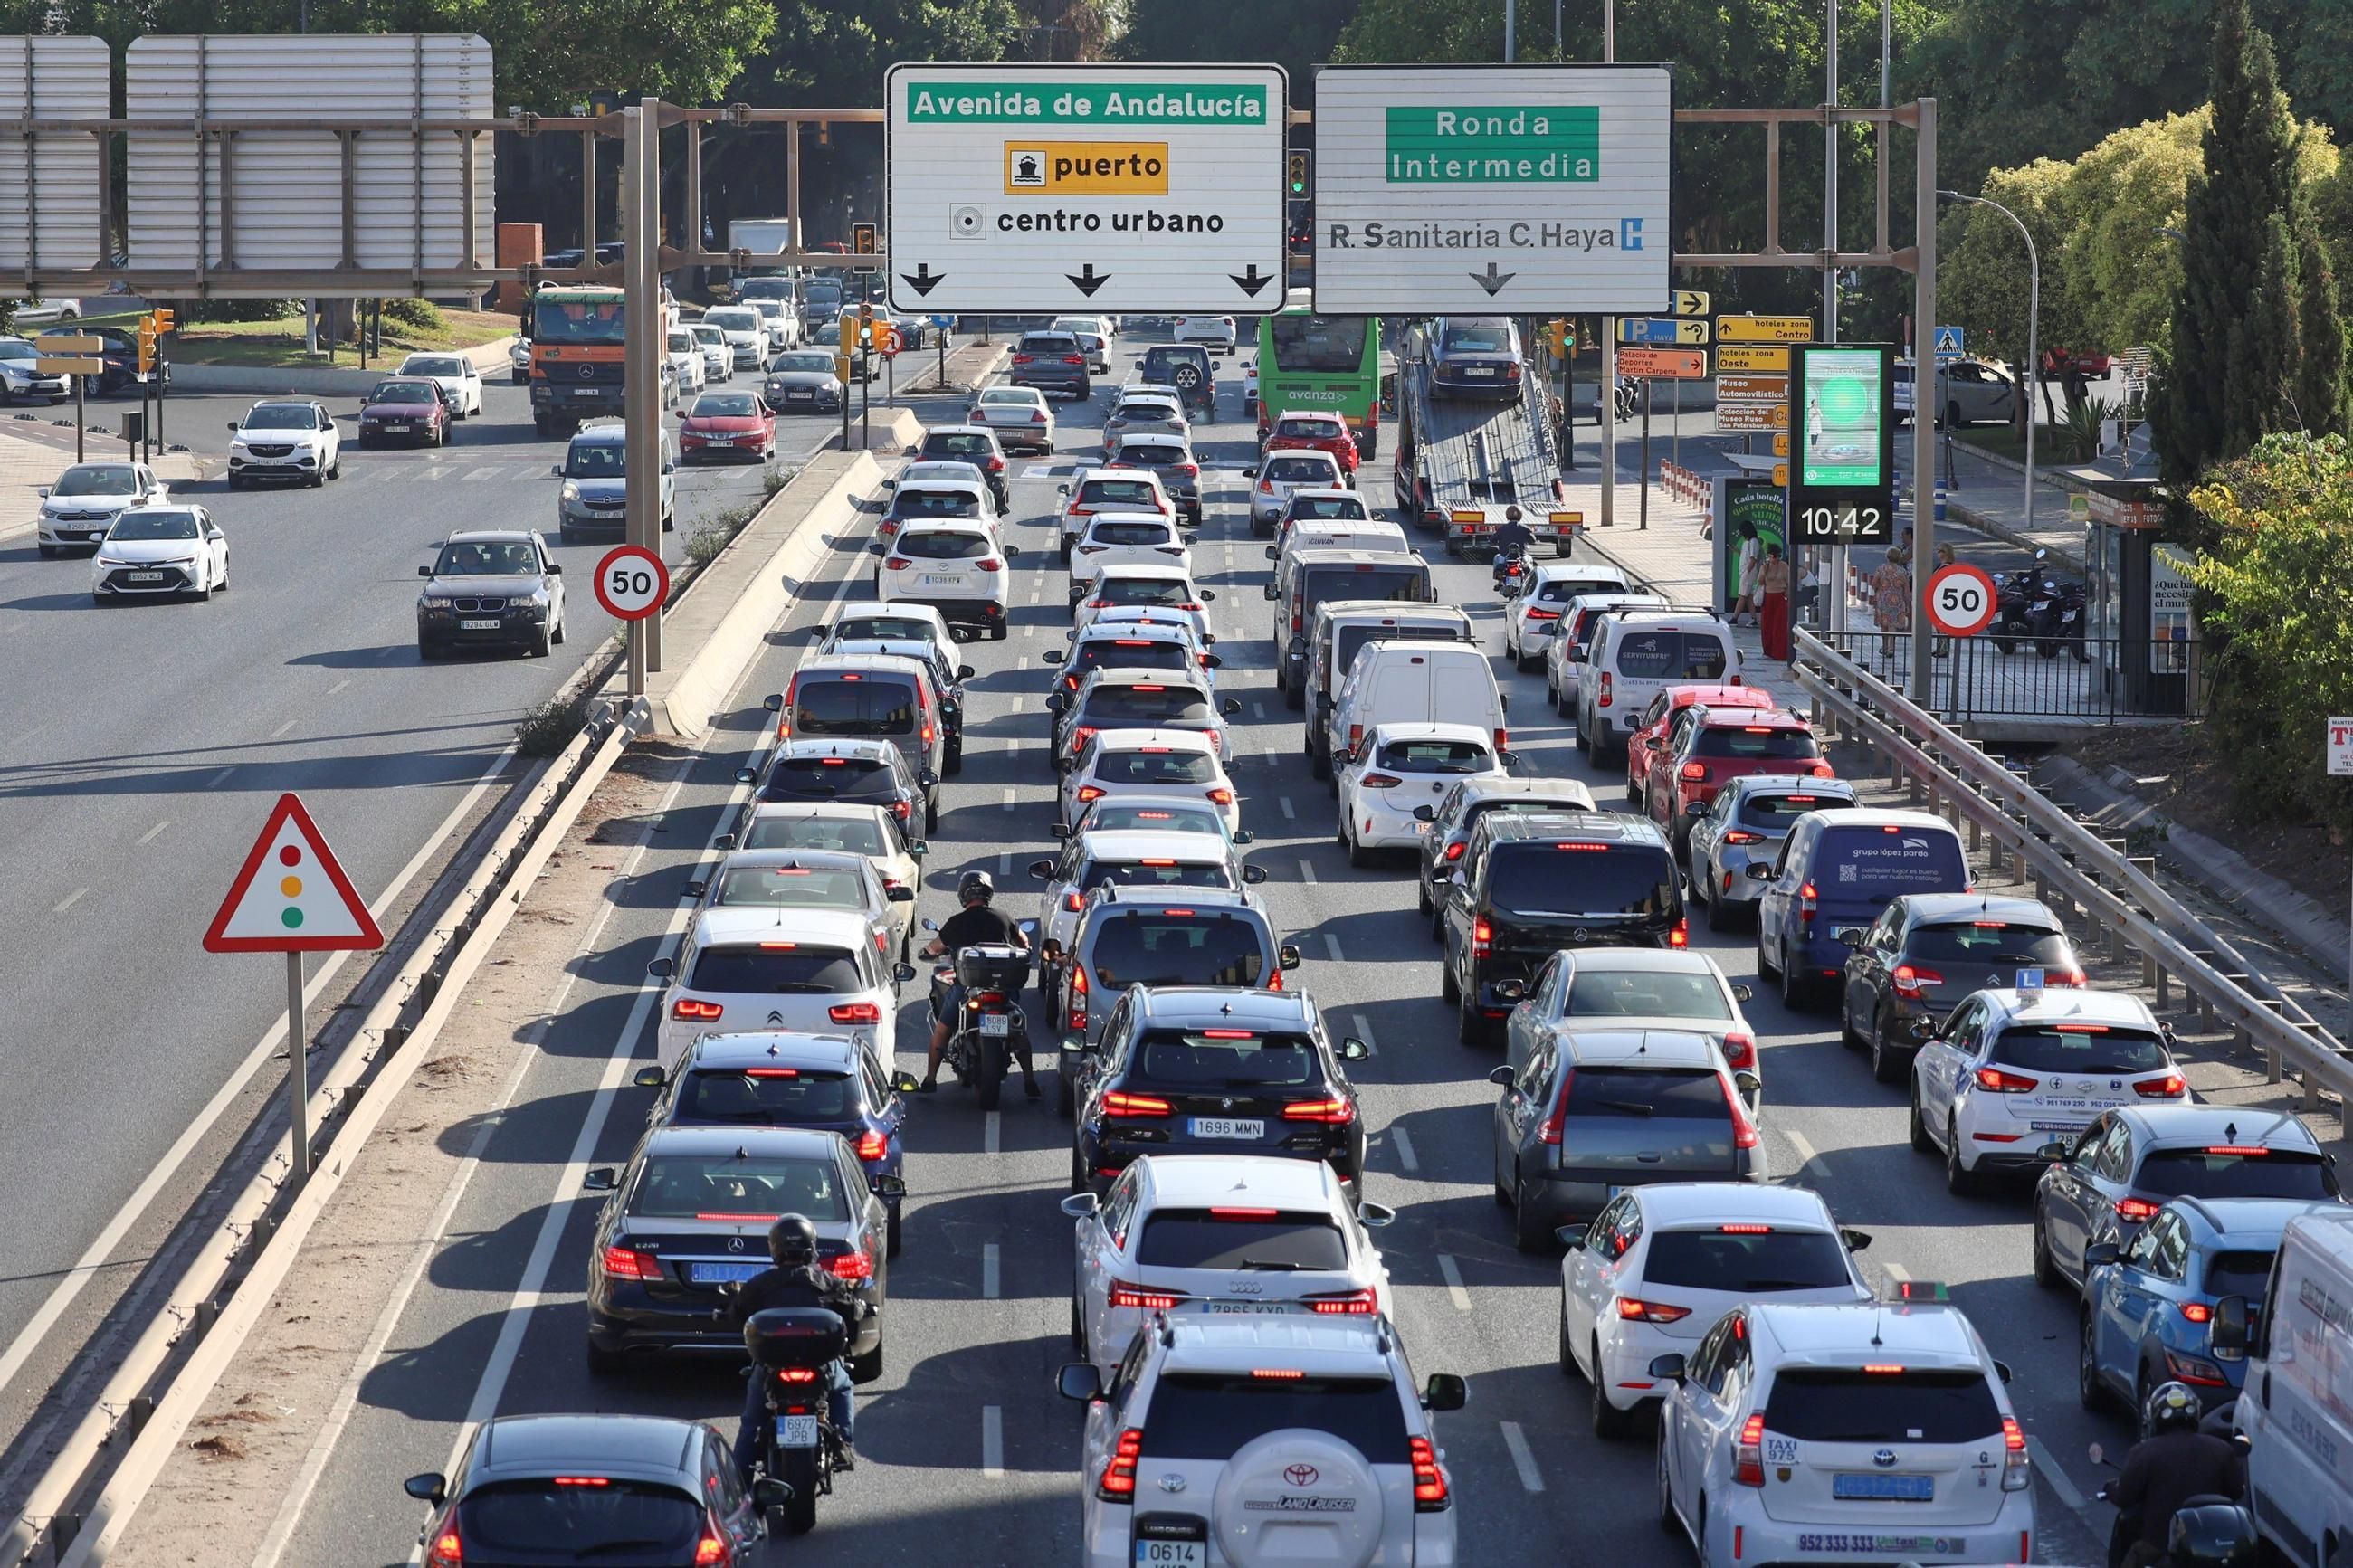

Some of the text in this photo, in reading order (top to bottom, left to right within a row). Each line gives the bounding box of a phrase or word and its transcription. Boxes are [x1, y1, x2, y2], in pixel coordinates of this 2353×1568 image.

[914, 91, 1261, 118] Avenida de Andalucía
[1436, 111, 1549, 135] Ronda
[1055, 154, 1161, 181] puerto
[1393, 154, 1592, 178] Intermedia
[997, 210, 1224, 233] centro urbano
[1330, 224, 1356, 248] R.
[1363, 223, 1500, 248] Sanitaria
[1509, 223, 1534, 248] C.
[1542, 223, 1614, 252] Haya
[1776, 330, 1810, 339] Centro
[1620, 351, 1646, 359] Palacio
[1619, 358, 1653, 366] Deportes
[1646, 367, 1677, 375] Carpena
[1720, 379, 1748, 387] Museo
[1289, 391, 1335, 400] avanza
[1734, 493, 1783, 505] Cada botella
[1733, 505, 1749, 517] que
[1752, 511, 1782, 523] suma
[1802, 508, 1880, 535] 10:42
[613, 571, 651, 595] 50
[2154, 580, 2179, 590] ¿Qué
[1942, 588, 1980, 612] 50
[2154, 599, 2163, 608] el
[1853, 848, 1929, 858] grupo lópez pardo
[2023, 972, 2036, 987] L
[986, 1016, 1007, 1025] 8089
[1199, 1121, 1261, 1135] 1696 MMN
[787, 1418, 815, 1430] 6977
[788, 1430, 808, 1442] JPB
[1767, 1439, 1797, 1451] TAXI
[1769, 1450, 1795, 1461] 975
[1979, 1452, 1988, 1463] G
[1277, 1495, 1307, 1510] LAND
[1307, 1496, 1356, 1511] CRUISER
[1799, 1535, 1823, 1551] 952
[1826, 1535, 1848, 1551] 333
[1851, 1536, 1874, 1552] 333
[1149, 1544, 1195, 1562] 0614
